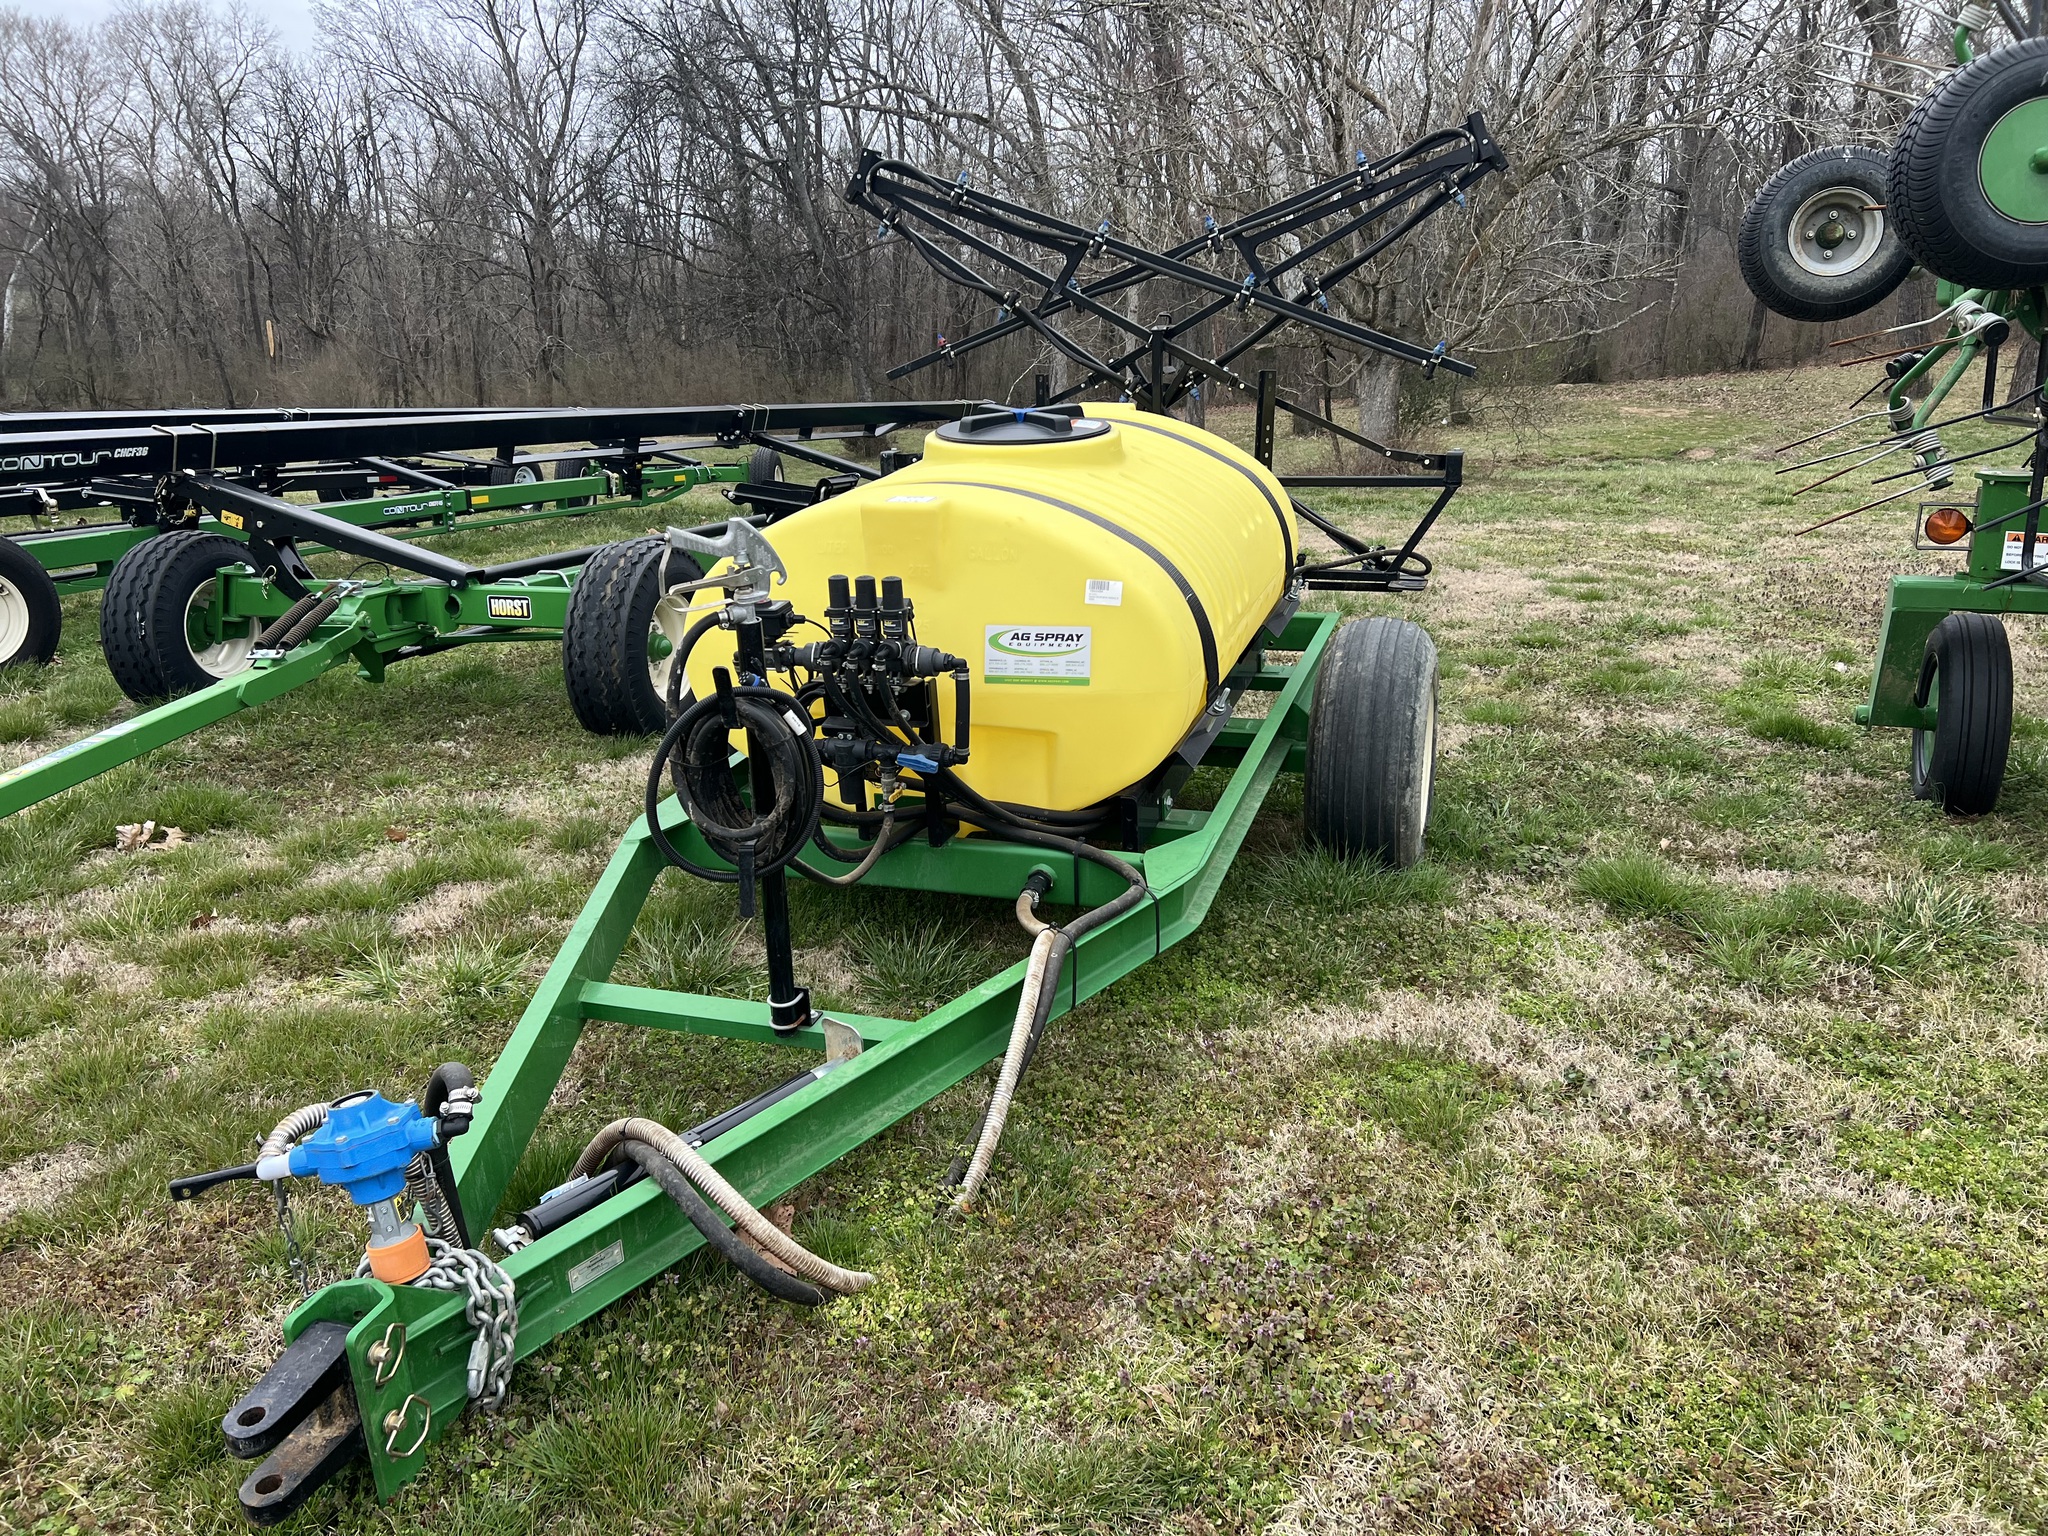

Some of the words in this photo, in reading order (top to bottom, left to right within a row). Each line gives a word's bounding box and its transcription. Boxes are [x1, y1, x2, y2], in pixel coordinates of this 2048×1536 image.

[0, 451, 112, 471] ONTOUR
[490, 598, 529, 617] HORST
[1010, 632, 1031, 641] AG
[1034, 633, 1084, 642] SPRAY
